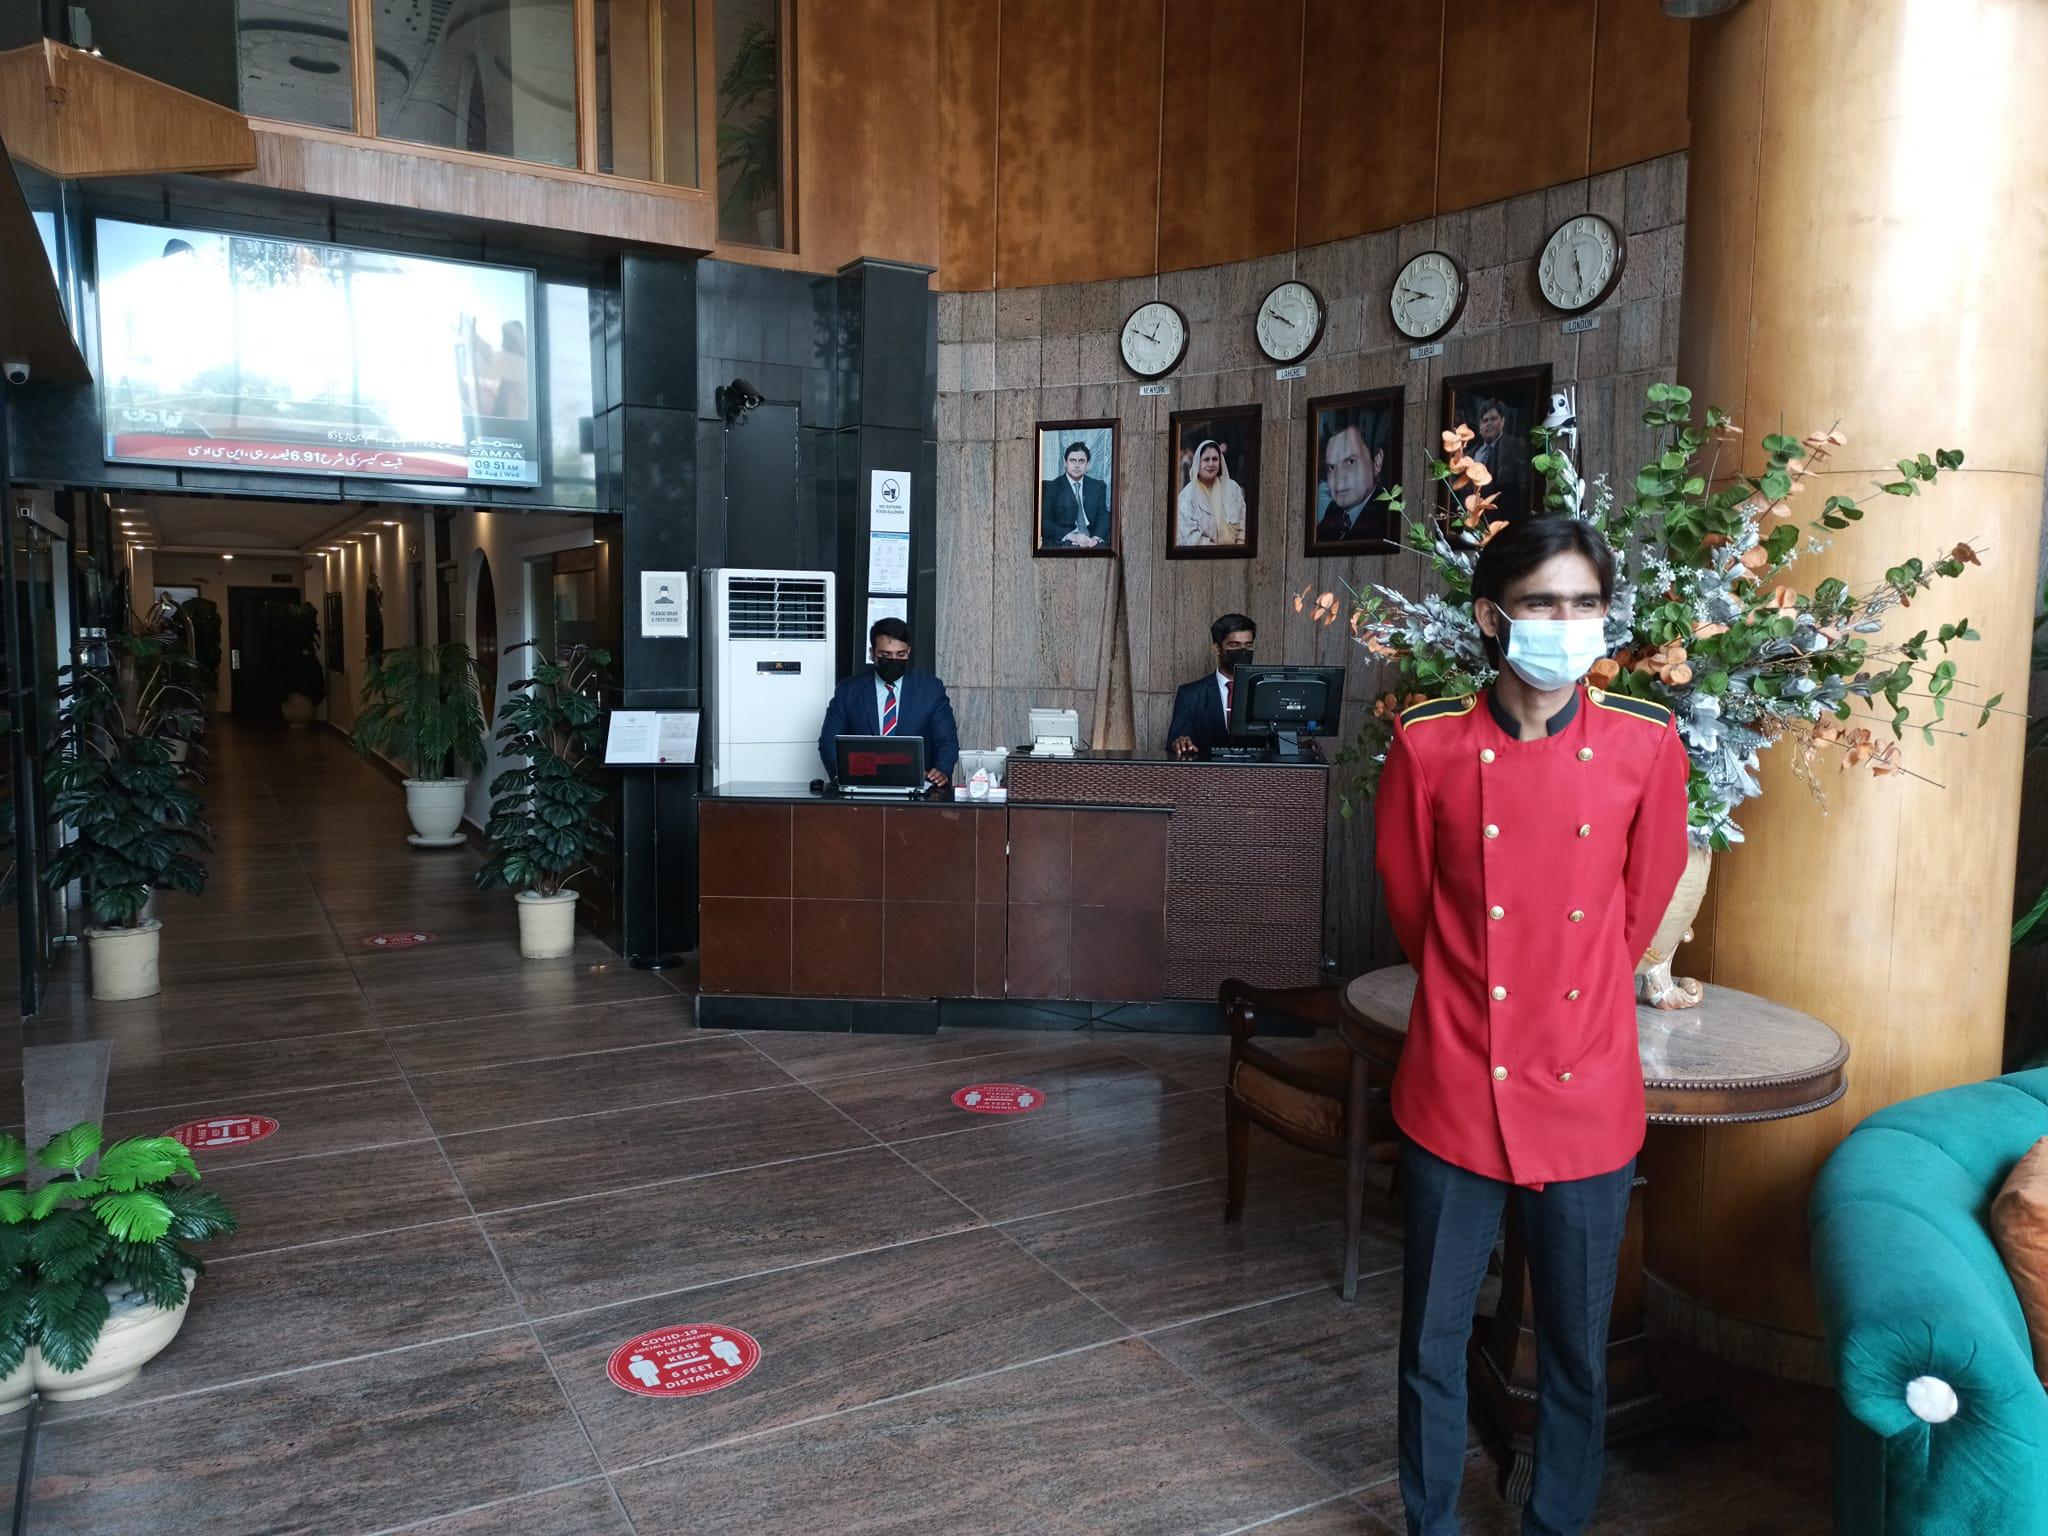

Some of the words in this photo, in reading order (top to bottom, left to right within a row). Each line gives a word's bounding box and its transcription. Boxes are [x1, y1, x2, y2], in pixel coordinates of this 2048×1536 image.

[1568, 319, 1593, 332] LONDON
[1418, 346, 1435, 357] DUBAI
[1281, 368, 1301, 378] LAHORE
[290, 449, 320, 463] 6.91
[470, 449, 522, 459] SAMAA
[475, 460, 490, 469] 09
[494, 461, 505, 470] 51
[634, 1343, 663, 1354] SOCIAL
[664, 1332, 712, 1347] DISTANCING
[640, 1329, 698, 1346] COVID-19
[656, 1341, 702, 1357] PLEASE
[667, 1350, 699, 1363] KEEP
[671, 1369, 680, 1378] 6
[682, 1362, 713, 1376] FEET
[665, 1368, 731, 1389] DISTANCE
